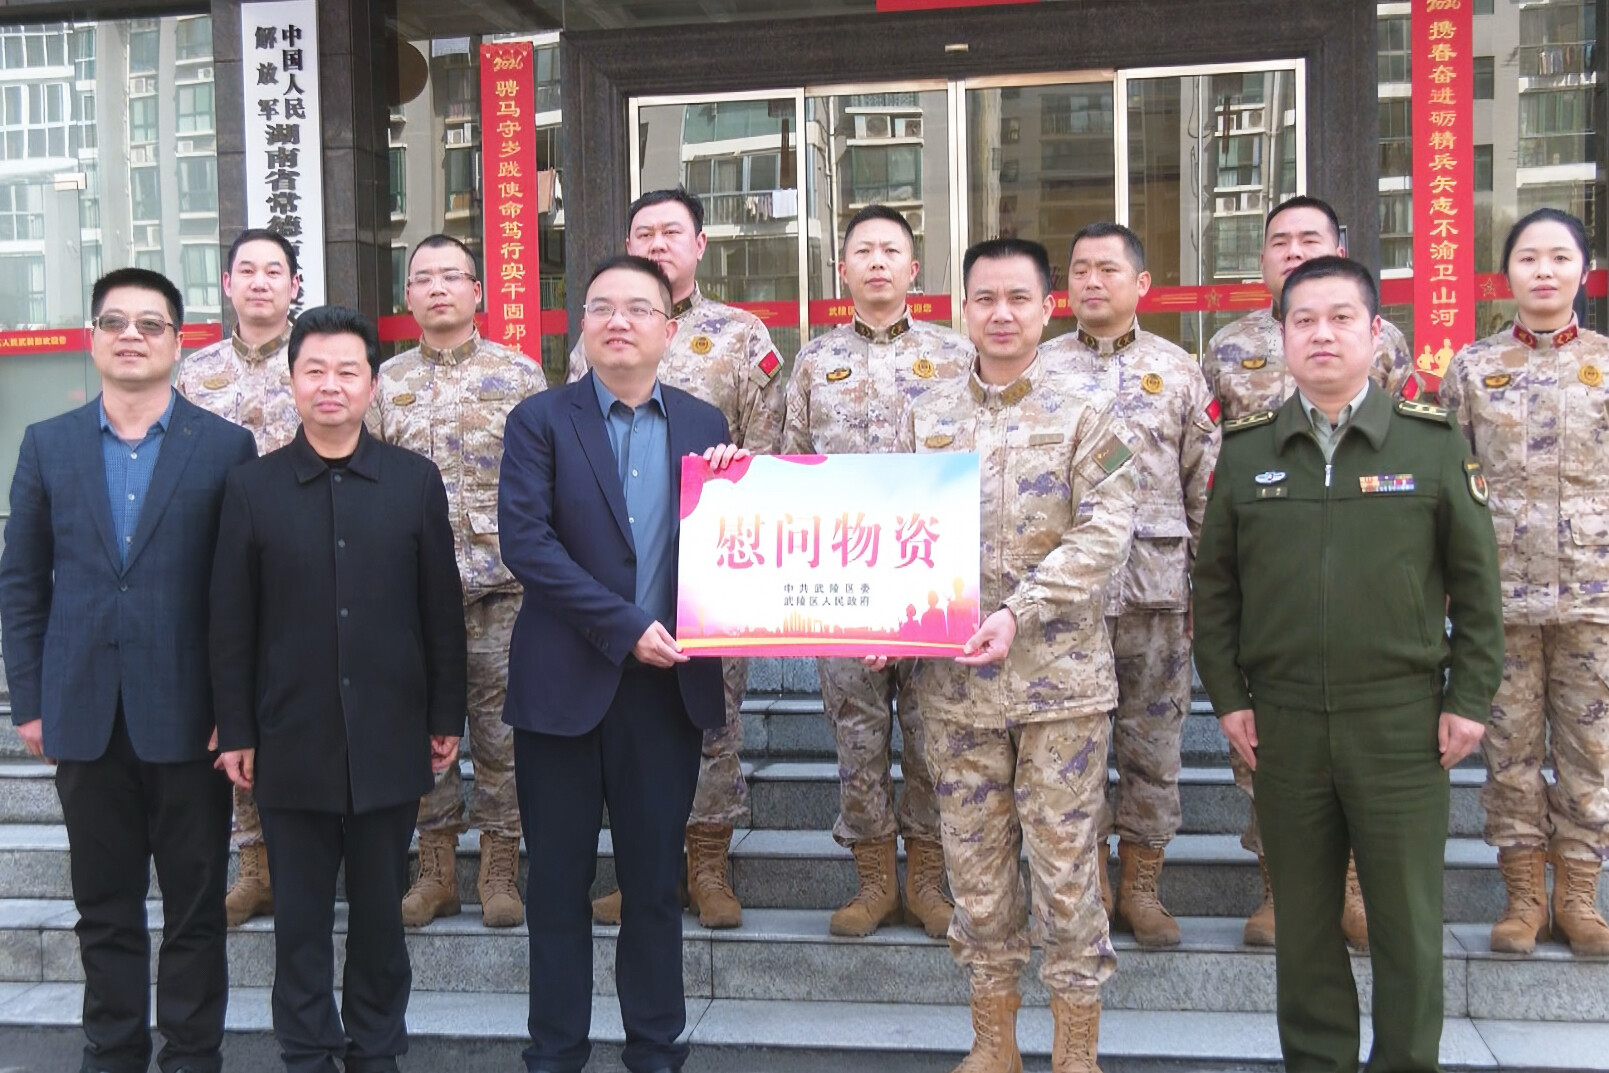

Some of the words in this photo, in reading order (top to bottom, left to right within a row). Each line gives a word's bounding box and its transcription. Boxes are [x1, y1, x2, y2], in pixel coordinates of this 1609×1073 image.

[254, 26, 279, 121] 解放军
[282, 24, 306, 120] 中国人民
[716, 512, 941, 569] 慰问物资
[783, 583, 871, 594] 中共武陵区委
[783, 595, 871, 607] 武陵区人民政府
